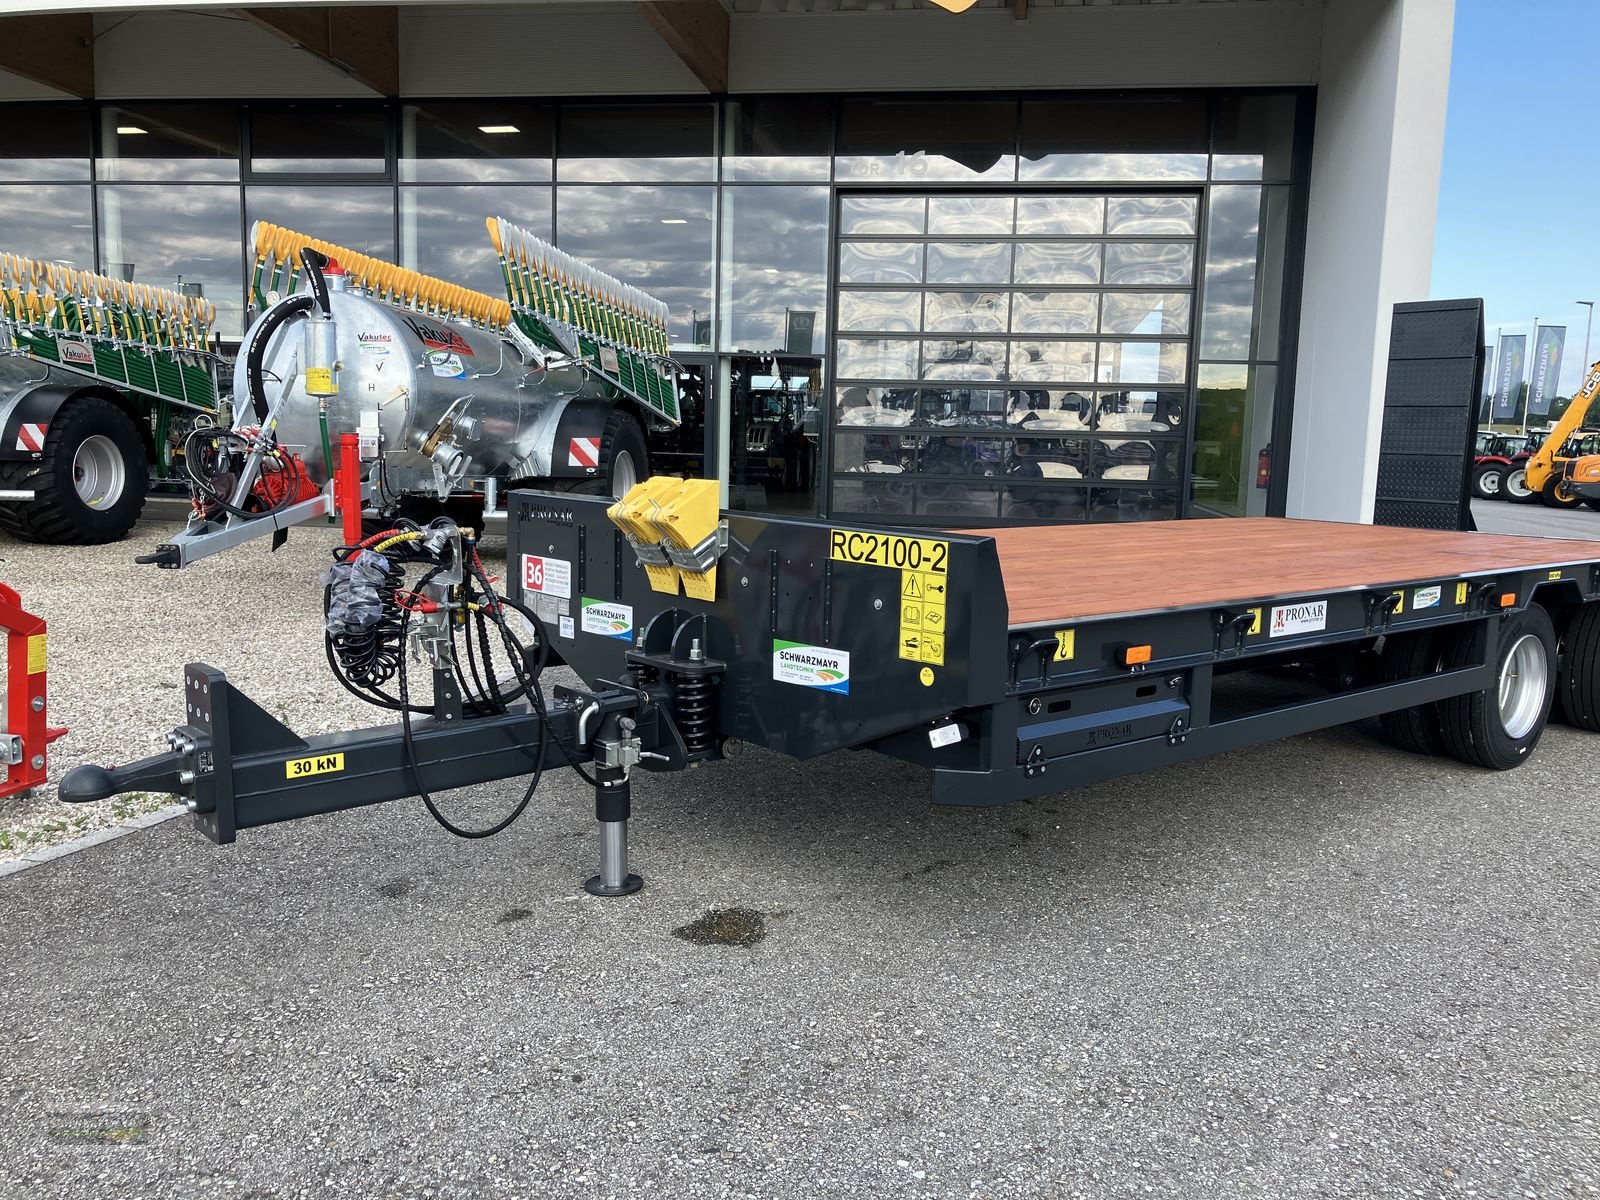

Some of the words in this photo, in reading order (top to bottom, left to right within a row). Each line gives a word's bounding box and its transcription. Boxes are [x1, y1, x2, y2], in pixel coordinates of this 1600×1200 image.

[849, 163, 880, 176] TOR
[896, 150, 928, 175] 16
[358, 332, 392, 342] Vakutec
[62, 347, 92, 360] Vakutec
[375, 362, 384, 372] V
[1534, 343, 1550, 403] SCHWARZMAYR
[368, 383, 375, 391] H
[1501, 351, 1513, 408] SCHWARZMAYR
[1583, 371, 1600, 399] JCB
[531, 503, 573, 522] PRONAR
[831, 531, 947, 573] RC2100-2
[527, 562, 543, 585] 36
[585, 606, 626, 621] SCHWARZMAYR
[1286, 605, 1324, 621] PRONAR
[780, 651, 839, 669] SCHWARZMAYR
[781, 662, 815, 673] LANDTECHNIK
[293, 761, 312, 775] 30
[317, 756, 337, 771] kN
